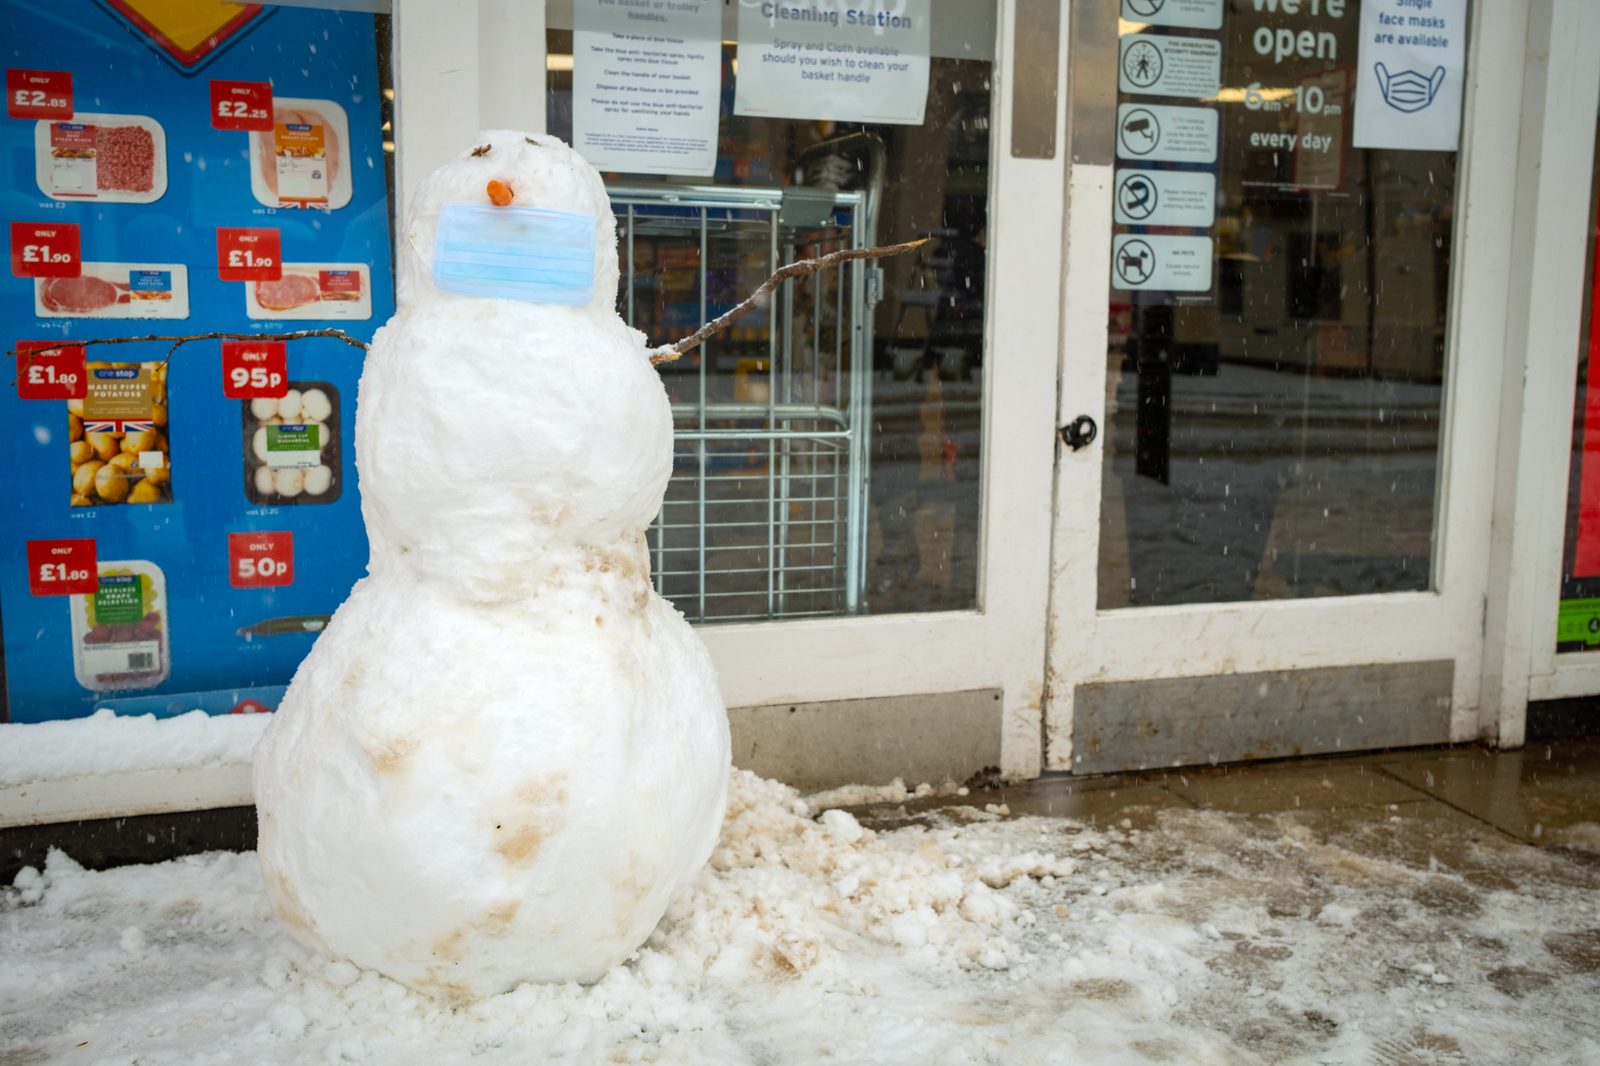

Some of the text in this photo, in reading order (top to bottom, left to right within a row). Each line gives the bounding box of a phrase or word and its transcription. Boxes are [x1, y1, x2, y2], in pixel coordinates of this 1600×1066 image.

[618, 0, 650, 8] basket
[667, 2, 700, 13] trolley
[1252, 0, 1346, 18] ere
[1396, 0, 1433, 10] Single
[627, 10, 668, 22] handles.
[761, 3, 839, 27] Cleaning
[846, 10, 912, 29] Station
[1378, 12, 1445, 29] face masks
[773, 39, 900, 57] Spray and Cloth available
[1253, 26, 1338, 64] open
[1374, 32, 1449, 48] are available
[762, 53, 909, 72] should you wish to clean your
[30, 76, 50, 84] ONLY
[801, 69, 871, 83] basket handle
[15, 90, 67, 107] £2.85
[1244, 82, 1282, 111] 6am
[1294, 86, 1342, 117] 10pm
[218, 101, 268, 119] £2.25
[1250, 132, 1332, 153] every day
[35, 230, 56, 238] ONLY
[23, 245, 71, 263] £1.90
[229, 250, 273, 267] £1.90
[242, 352, 268, 361] ONLY
[28, 365, 78, 384] £1.80
[115, 369, 135, 378] stop
[231, 367, 282, 388] 95p
[51, 547, 73, 555] ONLY
[249, 543, 274, 551] ONLY
[40, 563, 89, 582] £1.80
[238, 557, 287, 578] 50p
